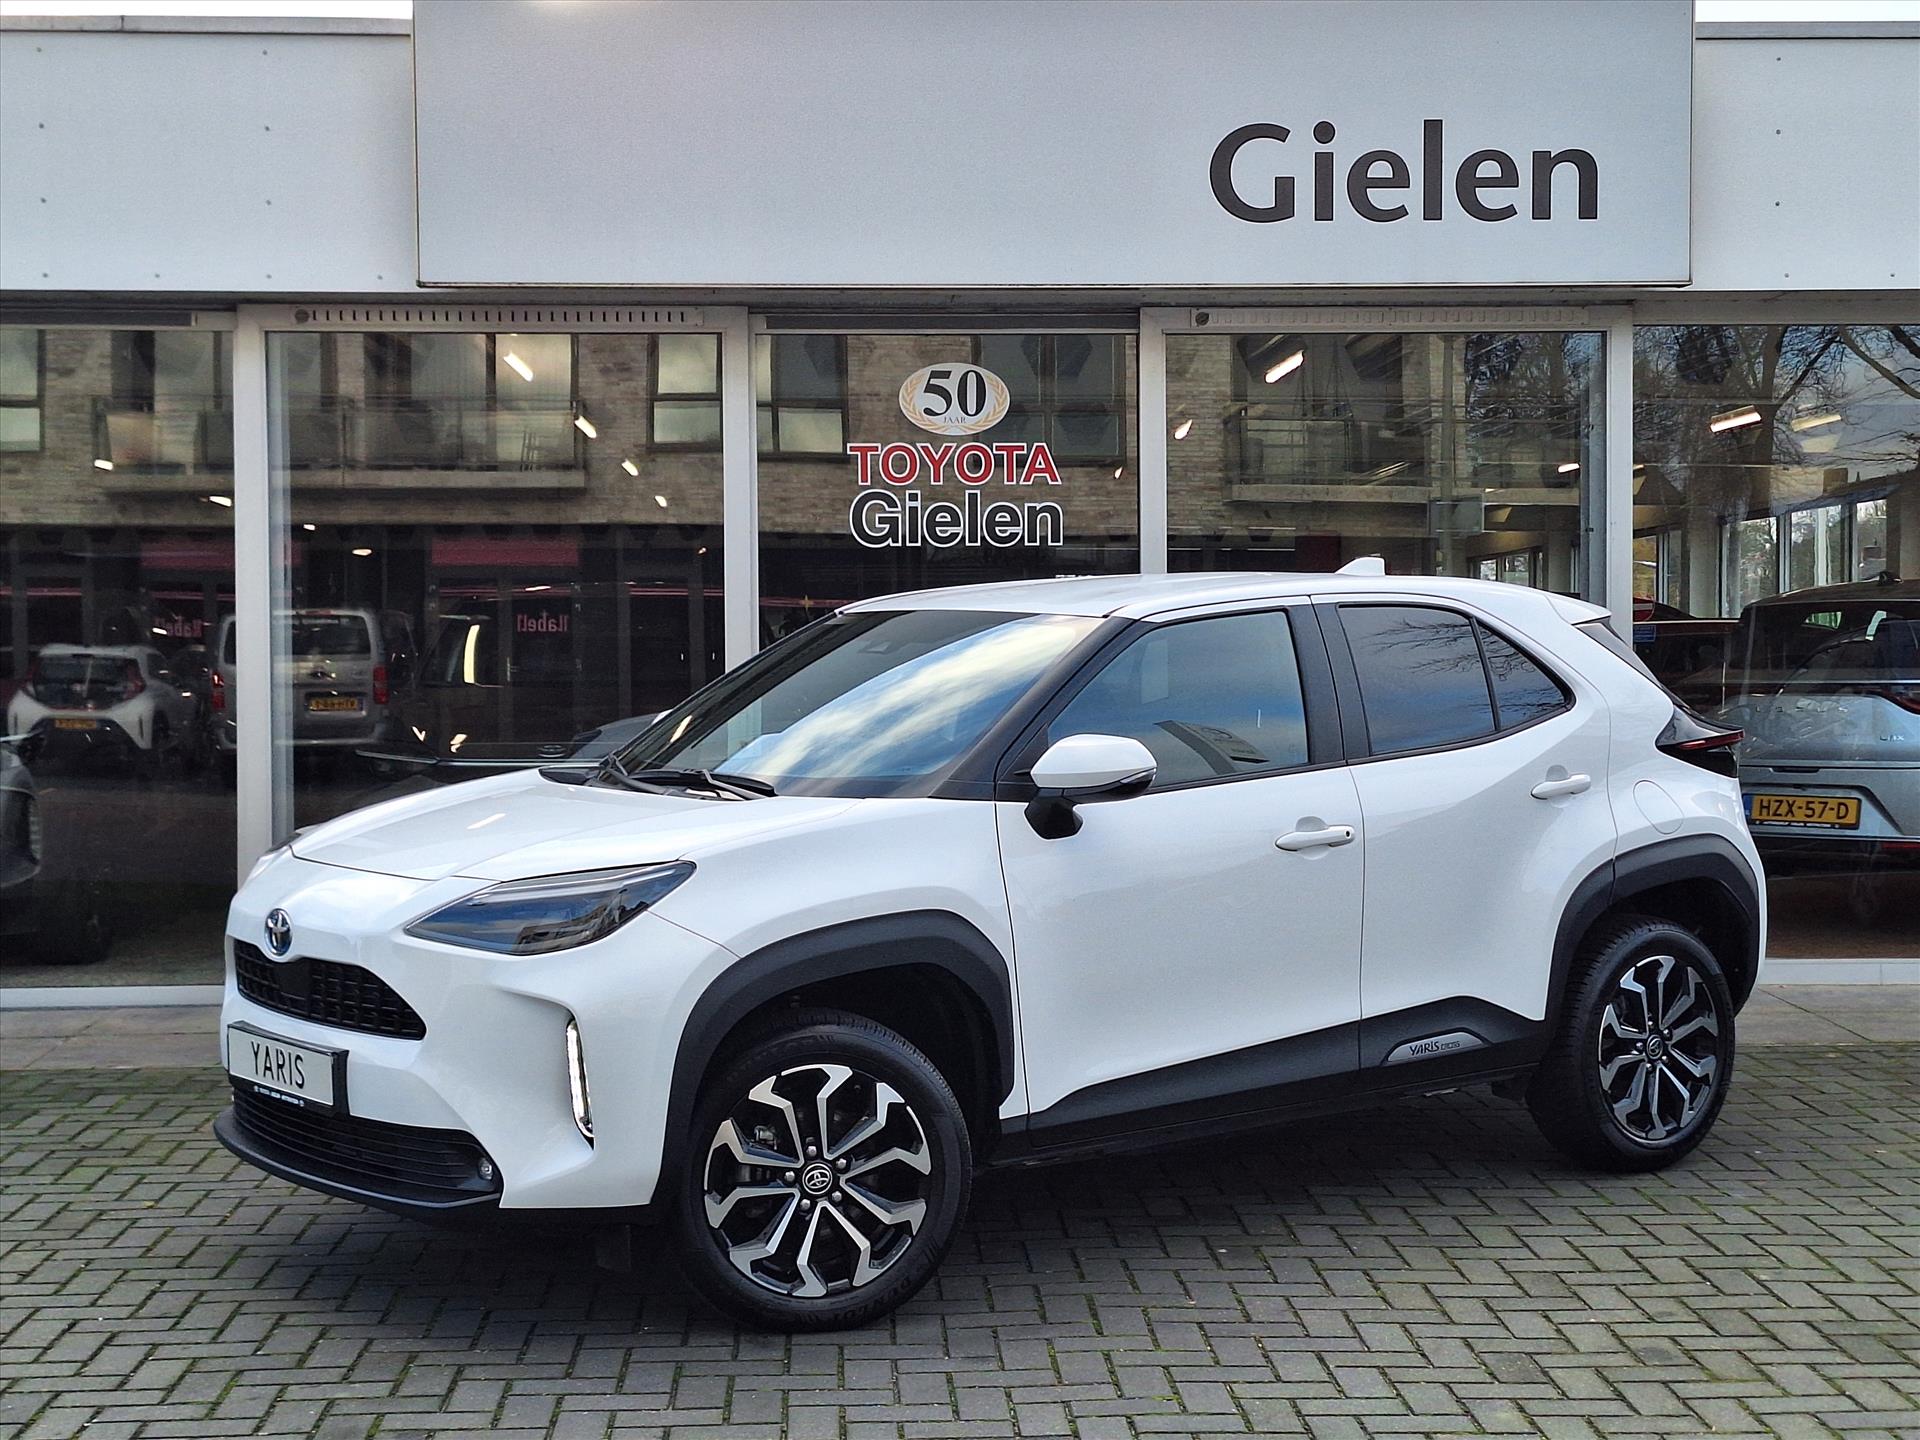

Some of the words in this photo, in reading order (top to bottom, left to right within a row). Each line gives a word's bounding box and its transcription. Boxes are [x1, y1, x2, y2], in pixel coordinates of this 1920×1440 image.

[1209, 119, 1598, 223] Gielen
[923, 370, 987, 417] 50
[943, 416, 967, 424] JAAR
[847, 443, 1062, 486] TOYOTA
[850, 489, 1064, 548] Gielen
[1758, 799, 1850, 820] HZX-57-D
[251, 1041, 305, 1089] YARIS
[1409, 1041, 1440, 1056] YARIS
